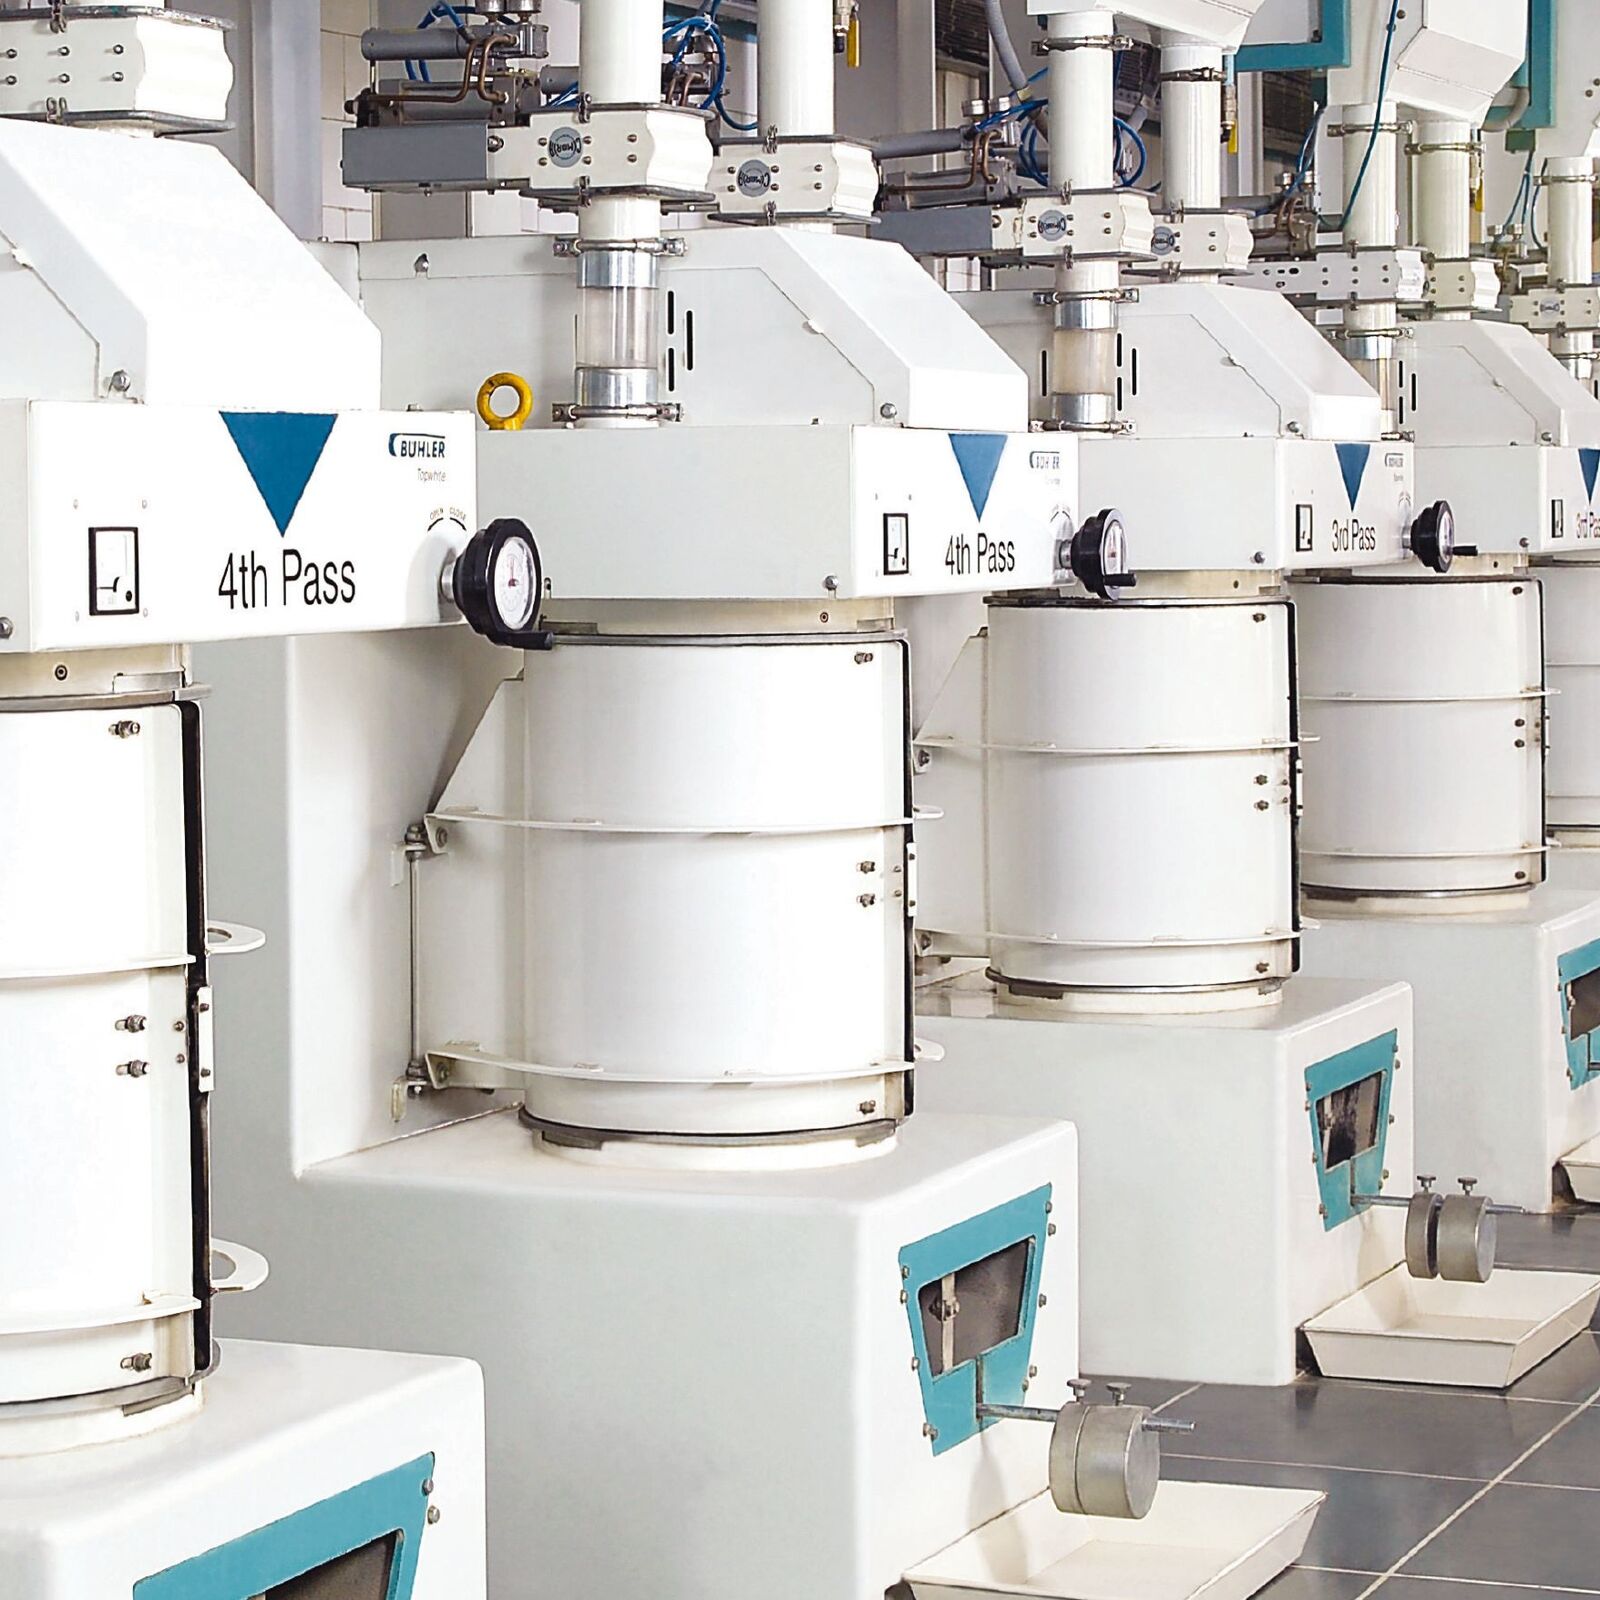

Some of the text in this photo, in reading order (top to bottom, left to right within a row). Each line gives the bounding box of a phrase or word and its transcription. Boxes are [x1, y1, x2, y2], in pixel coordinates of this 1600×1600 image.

[944, 532, 1015, 575] 4th Pass
[1332, 518, 1376, 552] 3rd Pass
[218, 548, 356, 609] 4th Pass
